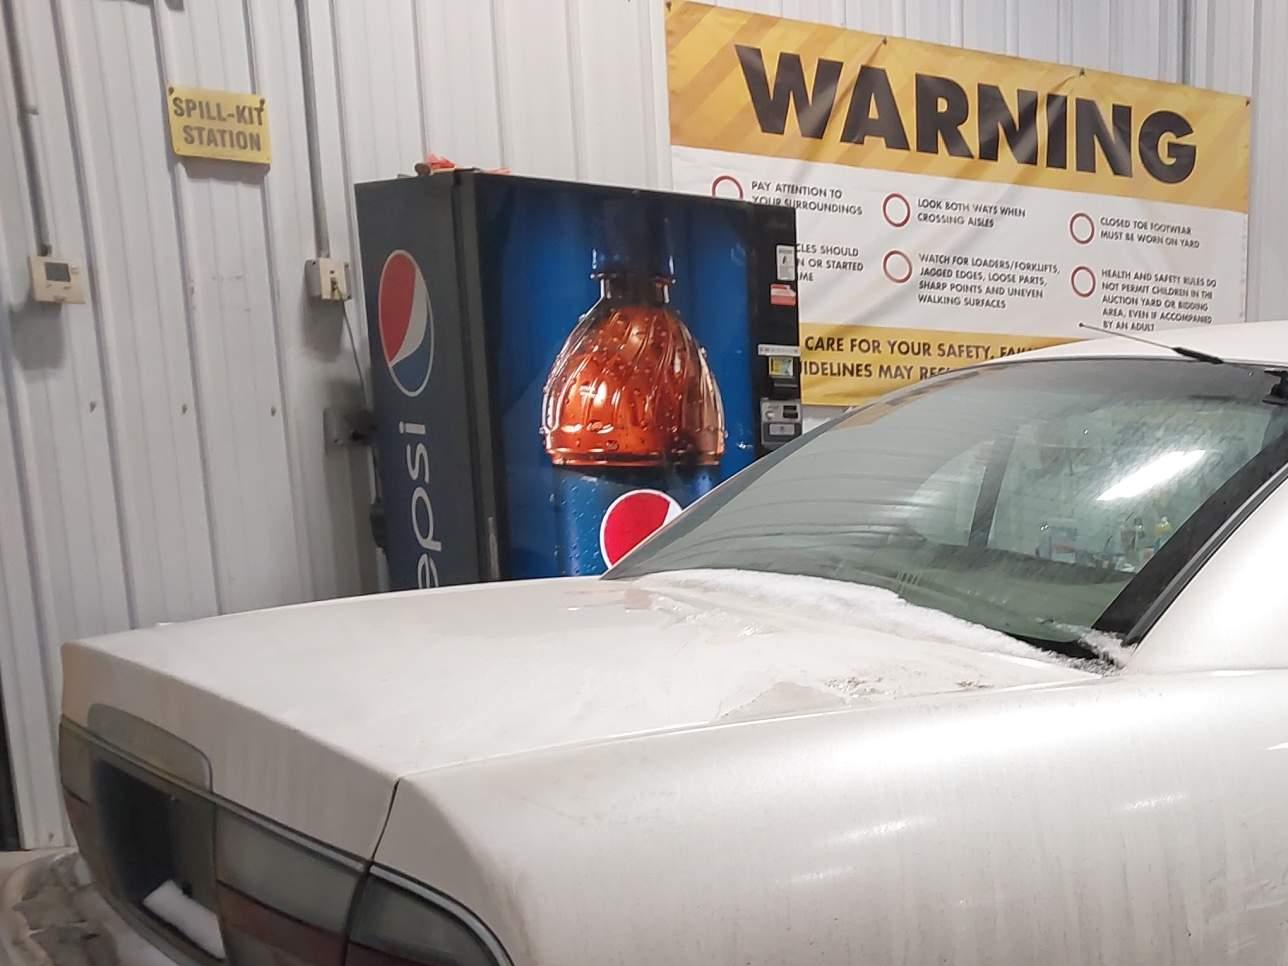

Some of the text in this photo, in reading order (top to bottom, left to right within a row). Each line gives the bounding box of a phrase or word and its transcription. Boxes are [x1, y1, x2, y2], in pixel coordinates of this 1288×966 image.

[172, 97, 264, 126] SPILL-KIT
[734, 44, 1197, 184] WARNING
[182, 125, 262, 152] STATION
[751, 181, 842, 199] PAY ATTENTION TO
[752, 196, 863, 215] YOUR SURROUNDINGS
[917, 198, 1026, 218] LOOK BOTH WAYS WHEN
[917, 212, 994, 228] CROSSING AISLES
[1100, 216, 1192, 235] CLOSED TOE FOOTWEAR
[1100, 229, 1200, 248] MUST BE WORN ON YARD
[820, 245, 859, 257] SHOULD
[808, 259, 822, 268] OR
[826, 260, 864, 273] STARTED
[918, 253, 1061, 274] WATCH FOR LOADERS/FORKLIFTS,
[920, 267, 1047, 286] JAGGED EDGES, LOOSE PARTS,
[1101, 269, 1217, 288] HEALTH AND SAFETY RULES DO
[918, 280, 1044, 298] SHARP POINTS AND UNEVEN
[1102, 282, 1213, 300] NOT PERMIT CHILDREN IN THE
[917, 294, 1006, 309] WALKING SURFACES
[1102, 295, 1208, 312] AUCTION YARD OR BIDDING
[1102, 308, 1213, 325] AREA, EVEN IF ACCOMPANIED
[1103, 320, 1155, 332] BY AN ADULT
[804, 335, 844, 353] CARE
[850, 338, 882, 354] FOR
[887, 339, 932, 357] YOUR
[878, 363, 914, 380] MAY
